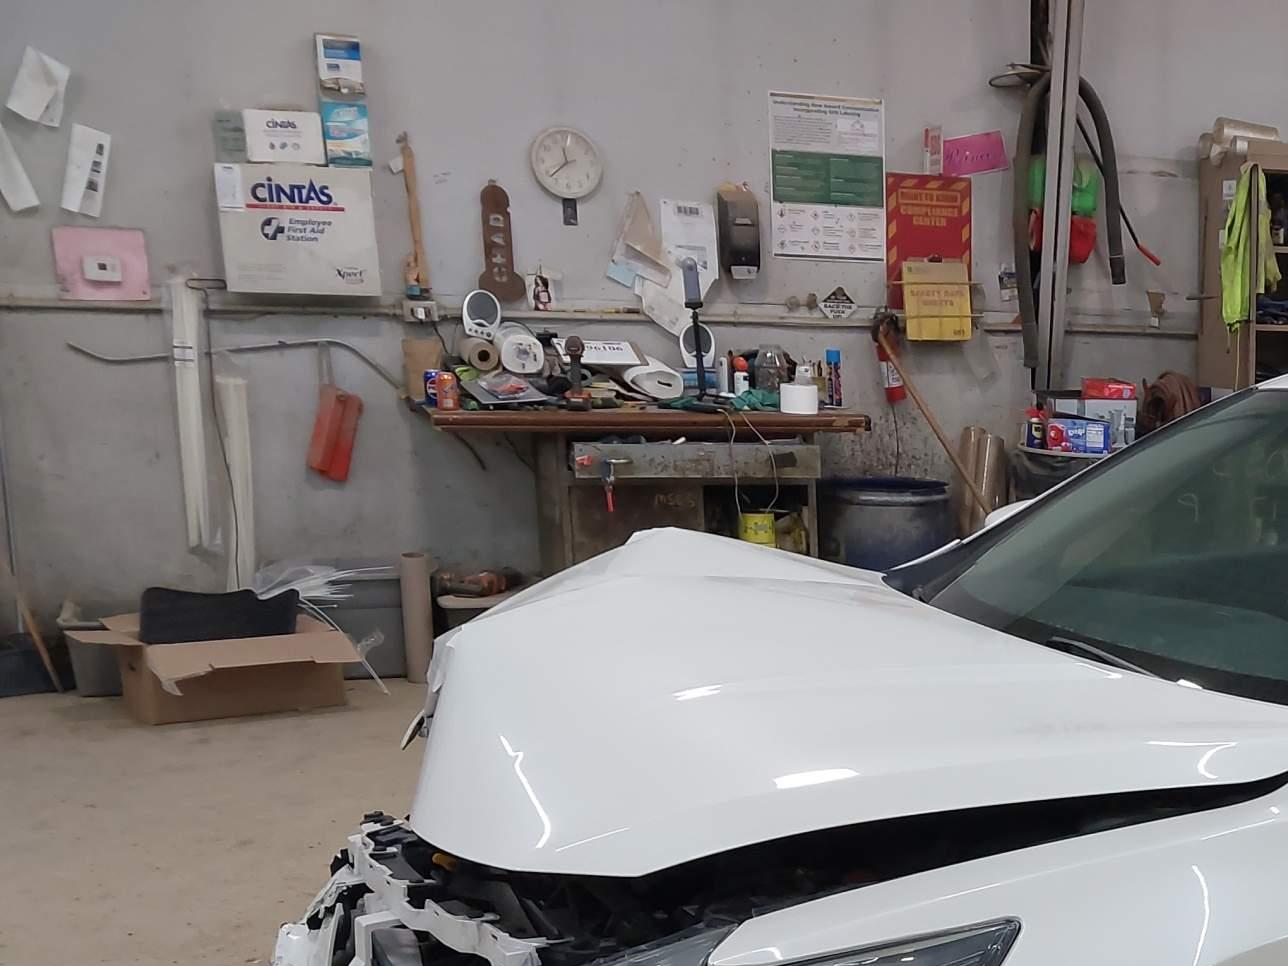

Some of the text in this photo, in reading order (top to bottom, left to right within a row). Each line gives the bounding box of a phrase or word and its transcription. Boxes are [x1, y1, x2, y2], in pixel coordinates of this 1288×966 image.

[289, 218, 332, 228] Employee
[288, 226, 307, 234] First
[286, 233, 319, 242] Station
